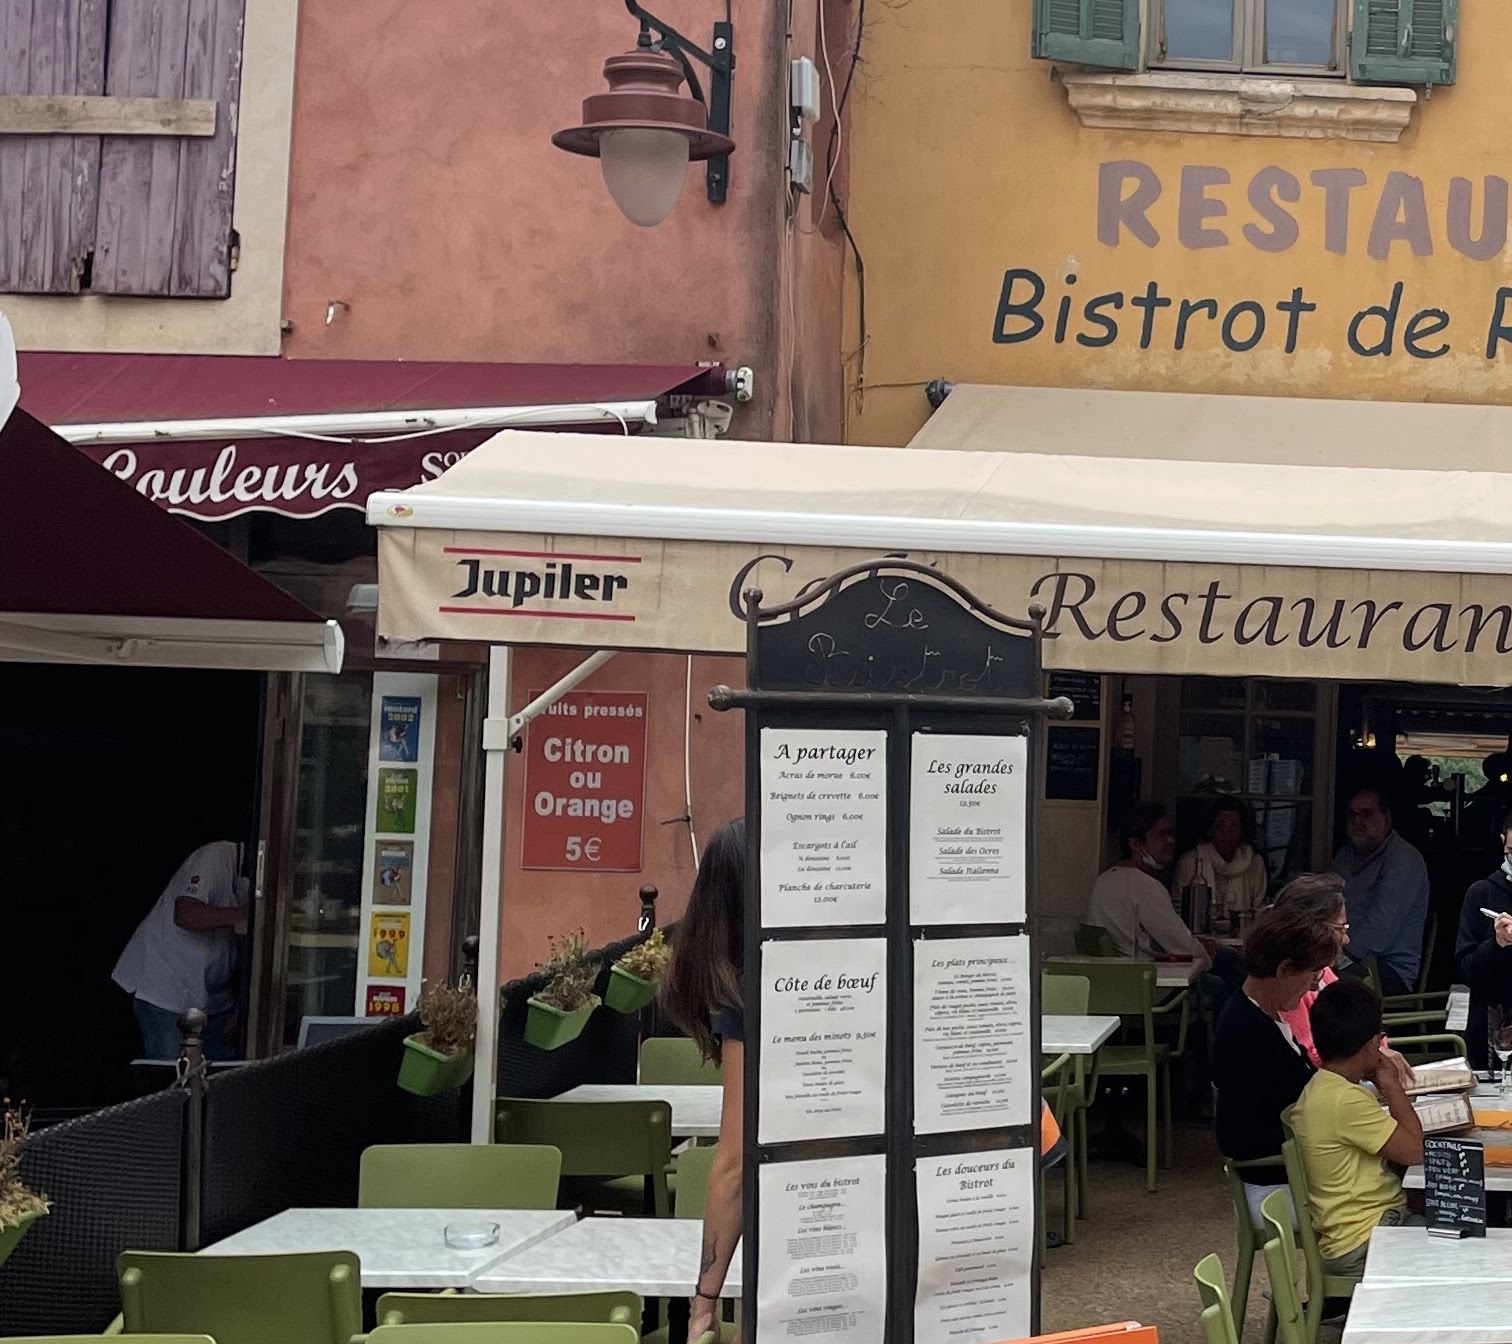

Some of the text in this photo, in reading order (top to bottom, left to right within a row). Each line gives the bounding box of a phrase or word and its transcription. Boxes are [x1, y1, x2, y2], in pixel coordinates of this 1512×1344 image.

[993, 269, 1316, 353] Bistrot
[1348, 281, 1451, 360] de
[451, 559, 628, 608] Jupiler
[541, 702, 577, 716] ruits
[544, 737, 629, 763] Citron
[773, 744, 876, 765] A partager
[927, 759, 1014, 778] Les grandes
[569, 771, 602, 789] ou
[943, 778, 998, 794] salades
[534, 791, 634, 824] Orange
[565, 836, 602, 862] 5€
[774, 971, 879, 994] Côte de bœuf
[369, 1001, 400, 1013] 1998
[935, 1158, 1015, 1177] Les douceurs du
[959, 1178, 994, 1191] Bistrot
